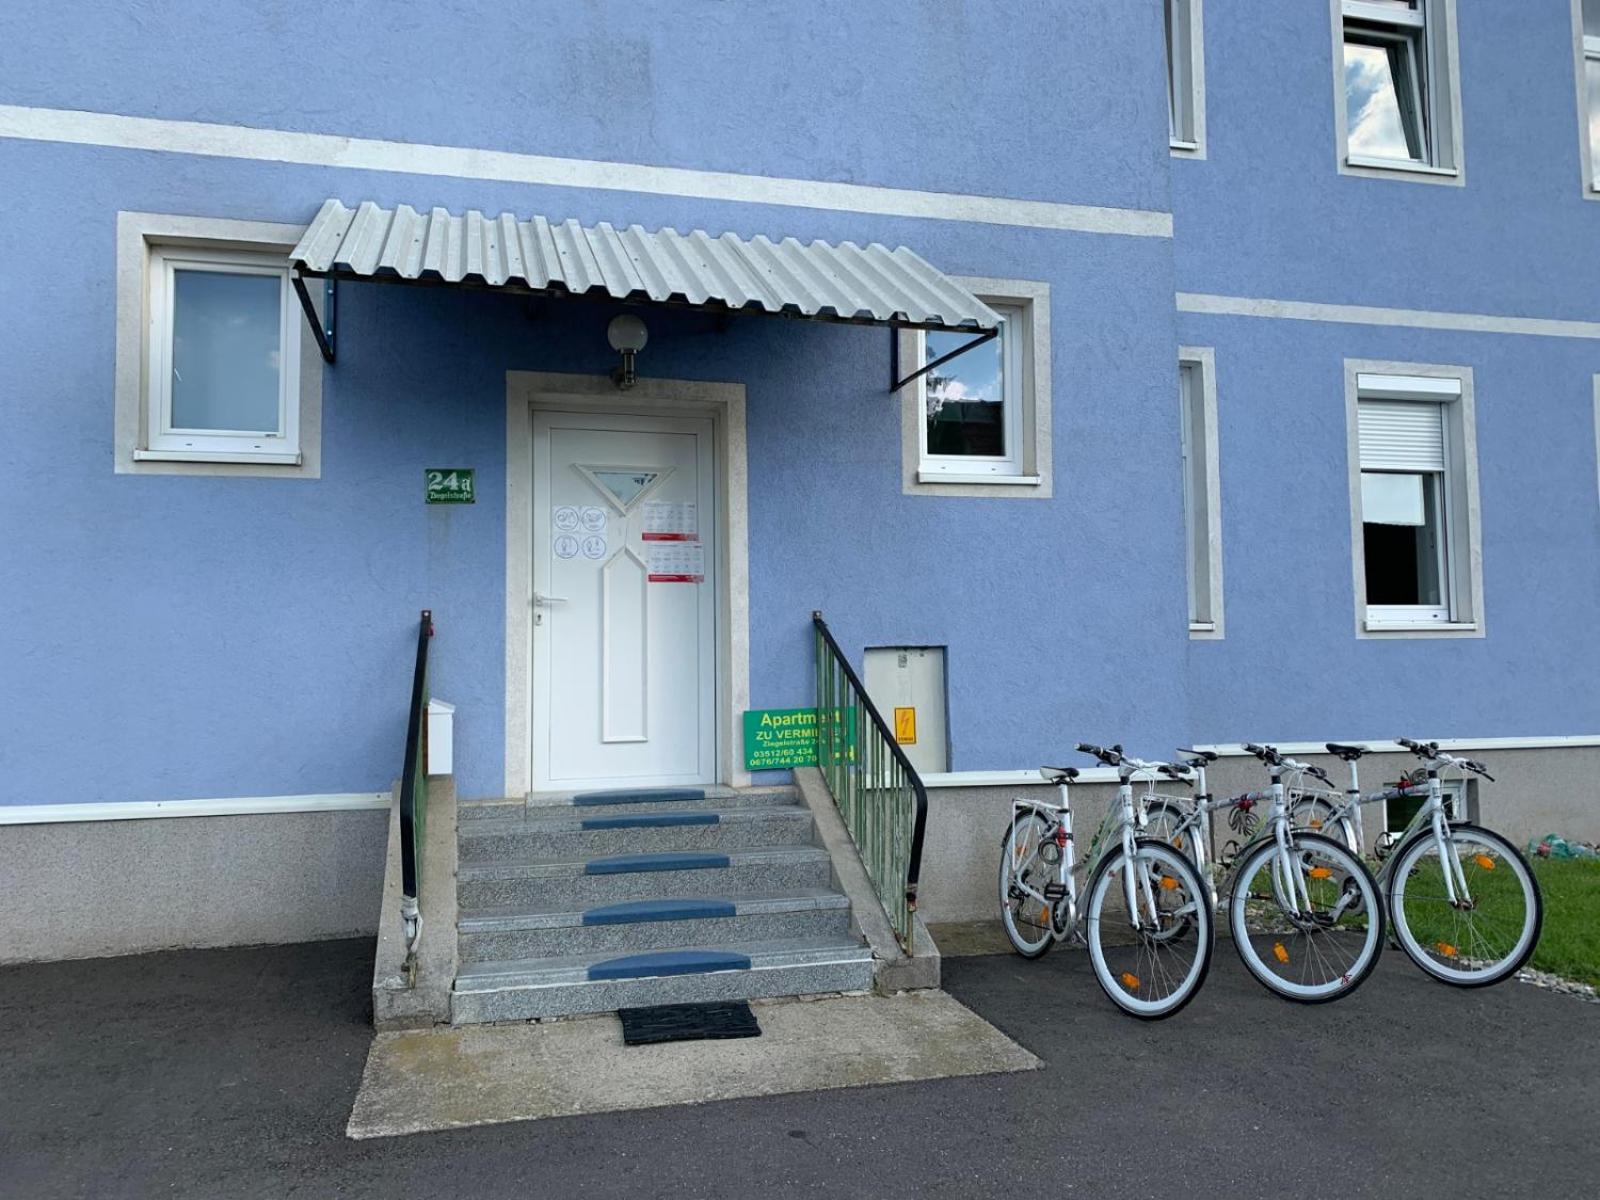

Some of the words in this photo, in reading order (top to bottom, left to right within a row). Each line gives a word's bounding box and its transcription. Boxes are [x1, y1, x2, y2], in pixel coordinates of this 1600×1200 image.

[755, 730, 773, 741] ZU
[753, 749, 795, 758] 03512/60
[796, 747, 813, 755] 434
[750, 756, 790, 766] 0676/744
[793, 755, 804, 764] 20
